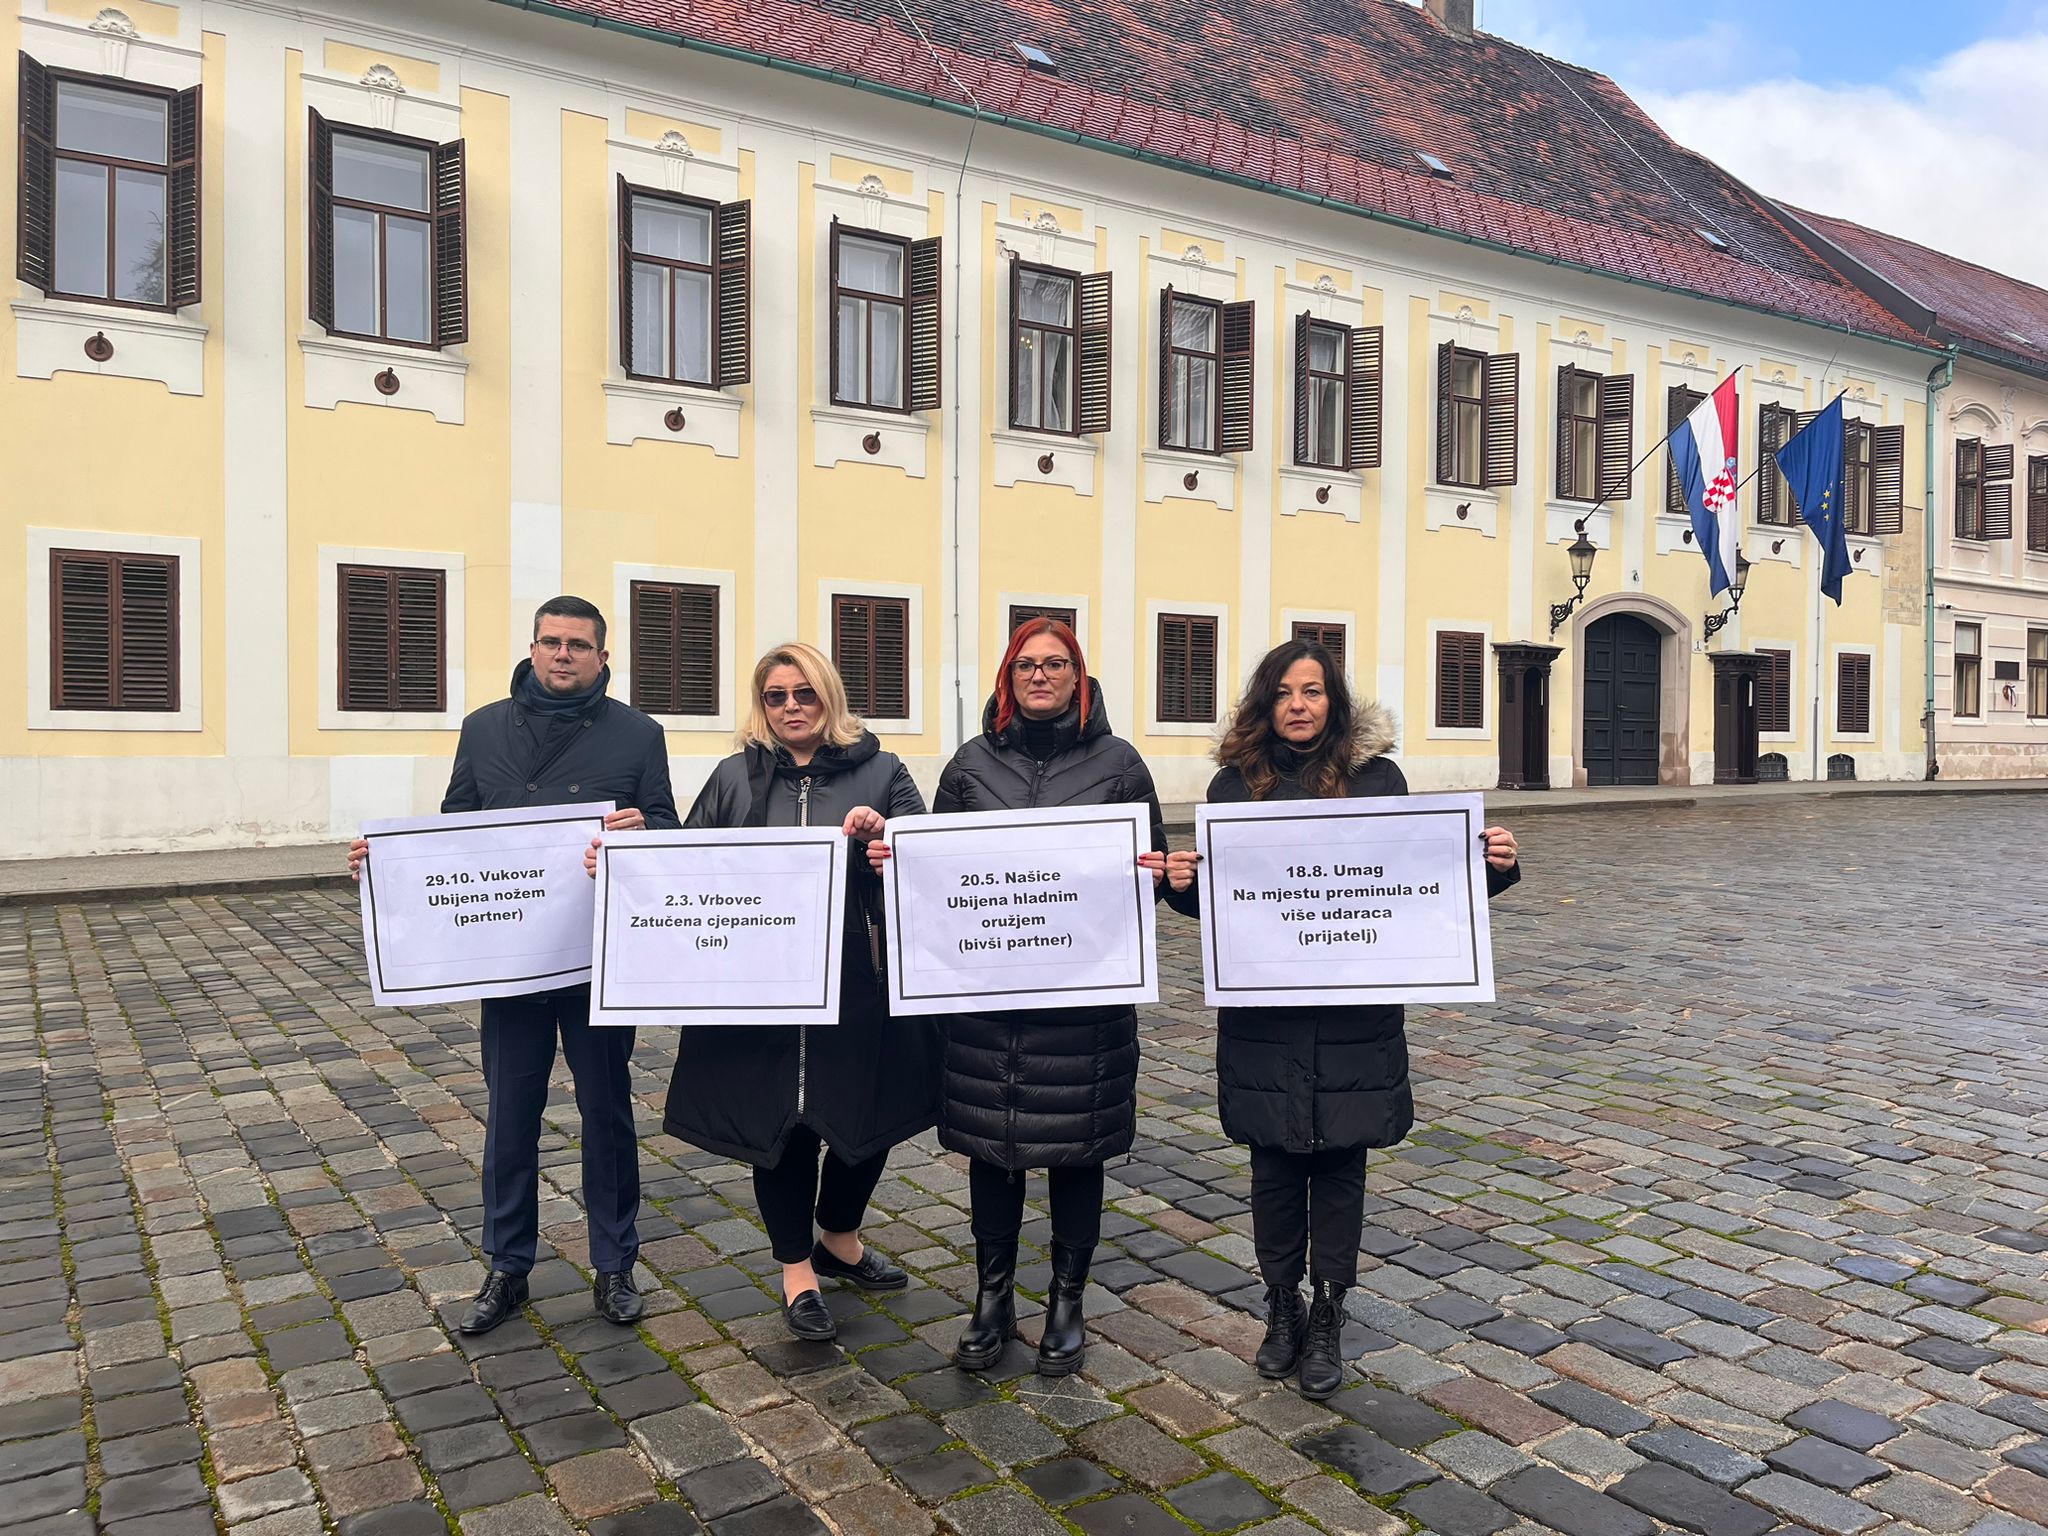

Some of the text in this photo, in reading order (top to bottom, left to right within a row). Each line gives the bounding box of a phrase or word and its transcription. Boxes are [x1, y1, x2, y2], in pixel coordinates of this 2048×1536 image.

[425, 868, 545, 887] 29.10. Vukovar
[960, 870, 1061, 887] 20.5. Našice
[1286, 864, 1384, 881] 18.8. Umag
[428, 887, 546, 908] Ubijena nožem
[664, 893, 762, 907] 2.3. Vrbovec
[947, 890, 1078, 911] Ubijena hladnim
[1233, 882, 1440, 903] Na mjestu preminula od
[454, 908, 523, 928] (partner)
[630, 914, 796, 930] Zatučena cjepanicom
[981, 914, 1046, 930] oružjem
[1280, 907, 1393, 922] više udaraca
[695, 935, 728, 951] (sin)
[958, 932, 1073, 954] (bivši partner)
[1298, 928, 1378, 946] (prijatelj)
